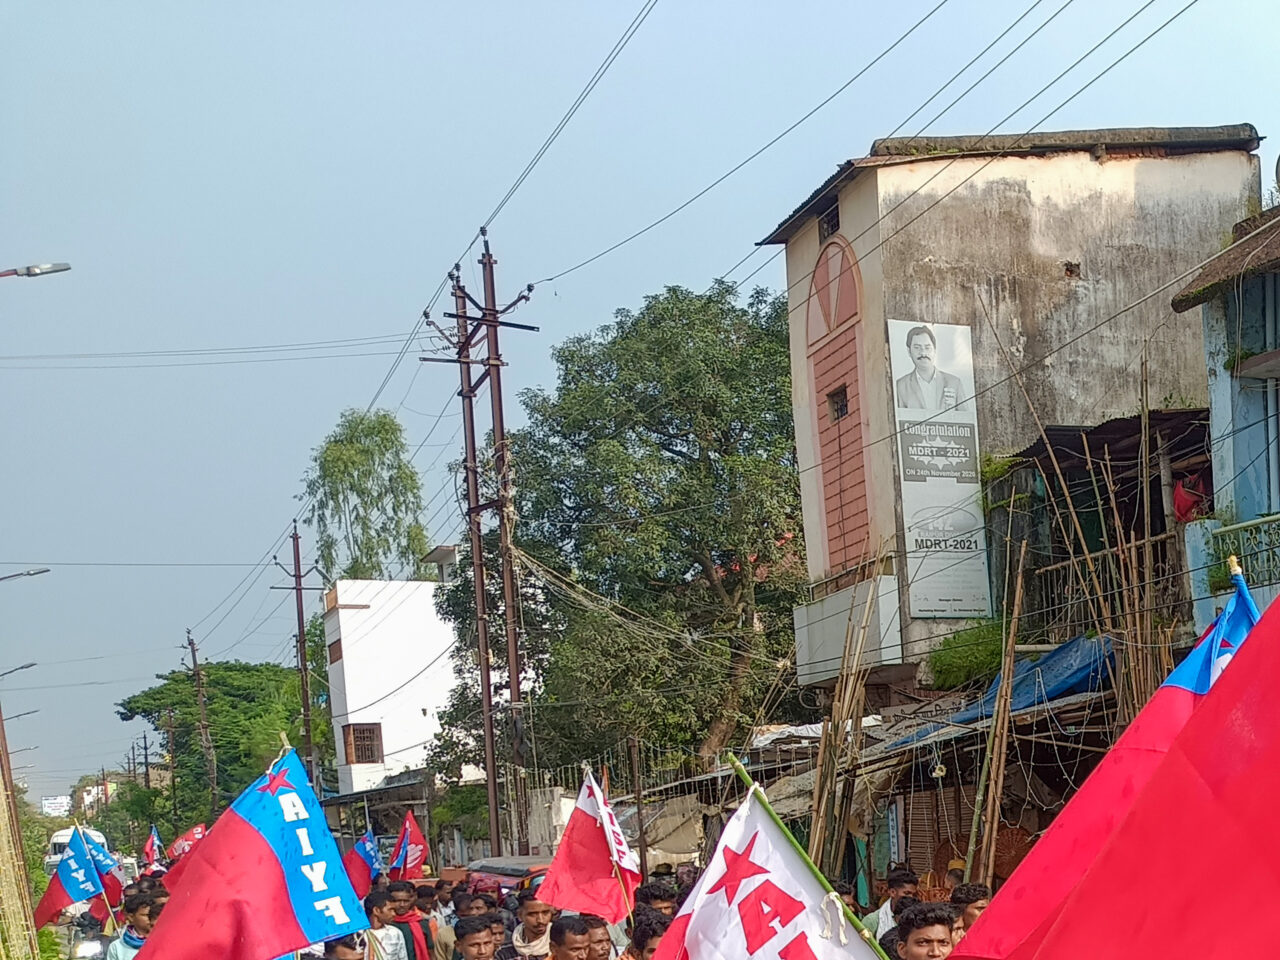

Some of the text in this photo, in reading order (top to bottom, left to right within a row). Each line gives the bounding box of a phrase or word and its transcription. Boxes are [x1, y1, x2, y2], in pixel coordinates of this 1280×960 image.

[904, 423, 971, 437] Congratulation
[908, 446, 938, 456] MDRT
[946, 448, 970, 457] 2021
[915, 538, 978, 550] MDRT-2021
